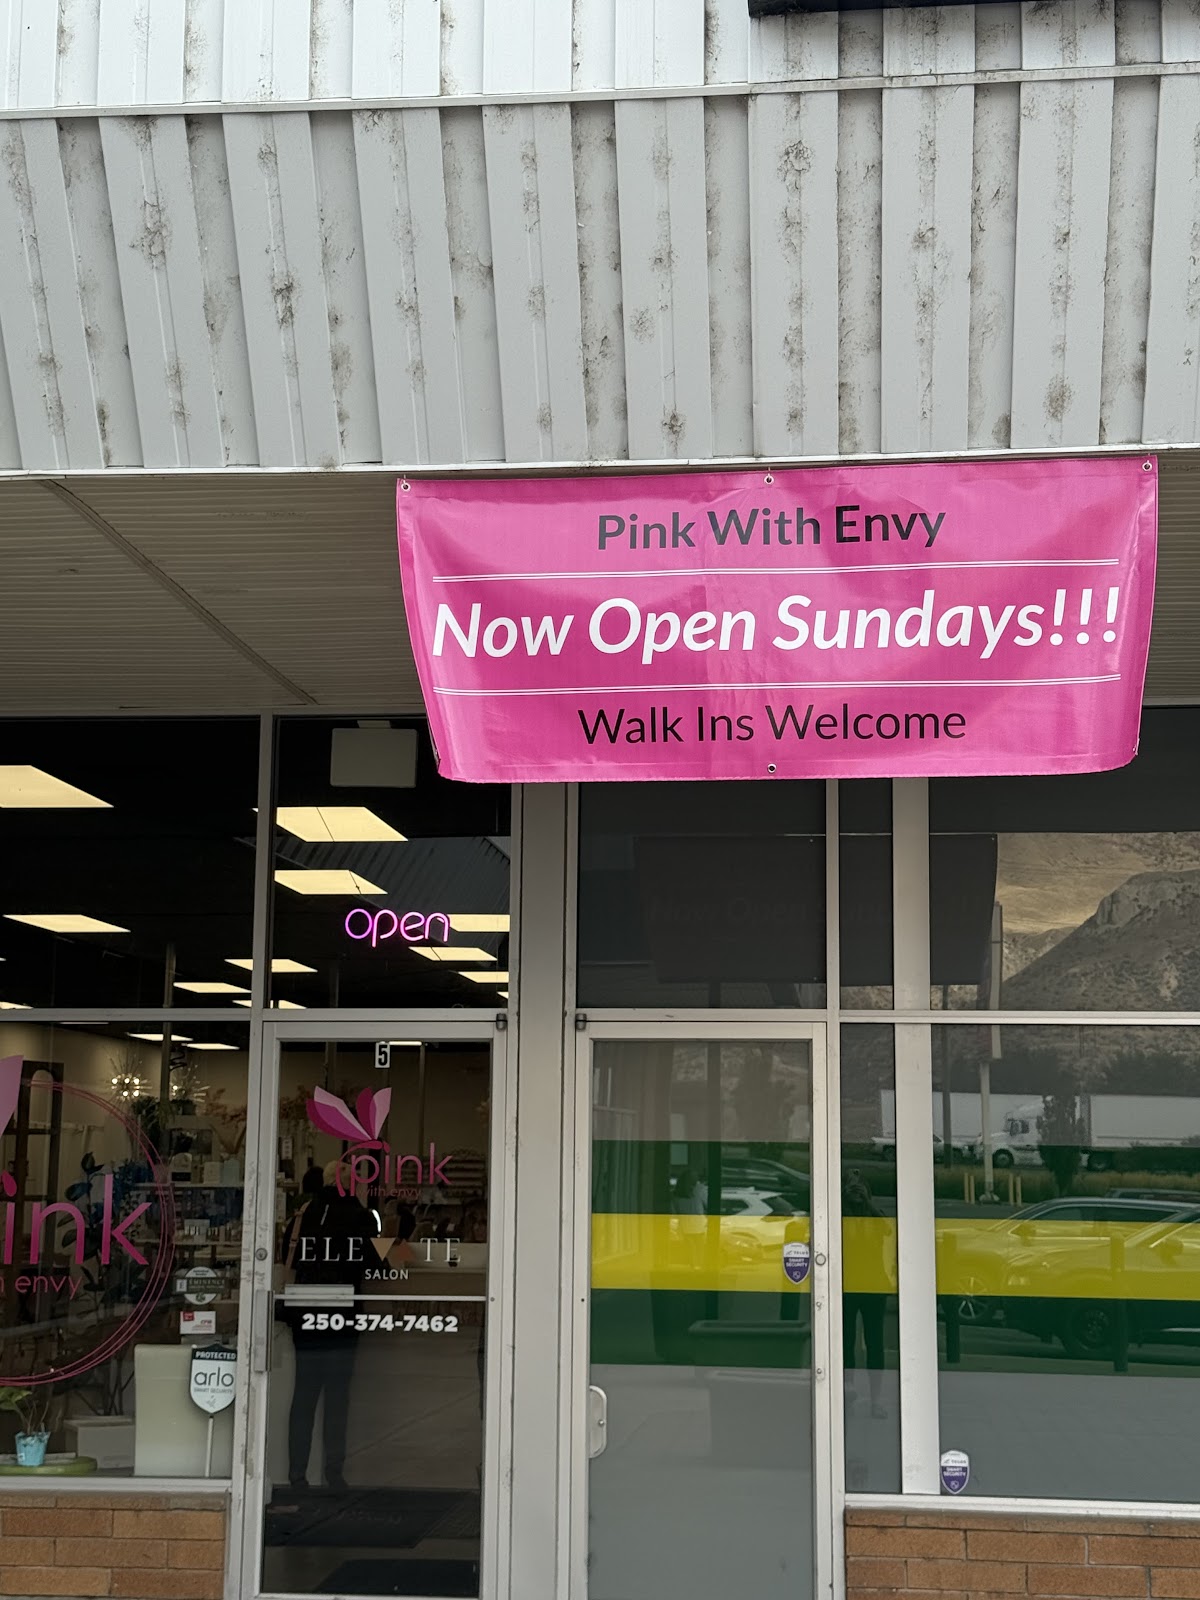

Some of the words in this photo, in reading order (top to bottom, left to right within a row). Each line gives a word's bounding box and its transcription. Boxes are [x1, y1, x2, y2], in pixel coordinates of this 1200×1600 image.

[598, 511, 696, 550] Pink
[707, 507, 821, 546] With
[835, 505, 946, 548] Envy
[432, 603, 574, 658] Now
[589, 597, 756, 665] Open
[772, 586, 1120, 660] Sundays!!!
[578, 706, 684, 744] Walk
[698, 706, 754, 741] Ins
[765, 703, 966, 741] Welcome
[345, 908, 450, 947] open
[378, 1044, 388, 1066] 5
[350, 1142, 454, 1197] pink
[0, 1170, 153, 1265] ink
[15, 1275, 82, 1300] envy
[365, 1269, 409, 1280] SALON
[302, 1313, 458, 1332] 250-374-7462
[195, 1351, 236, 1360] PROTECTED
[194, 1366, 234, 1387] arlo
